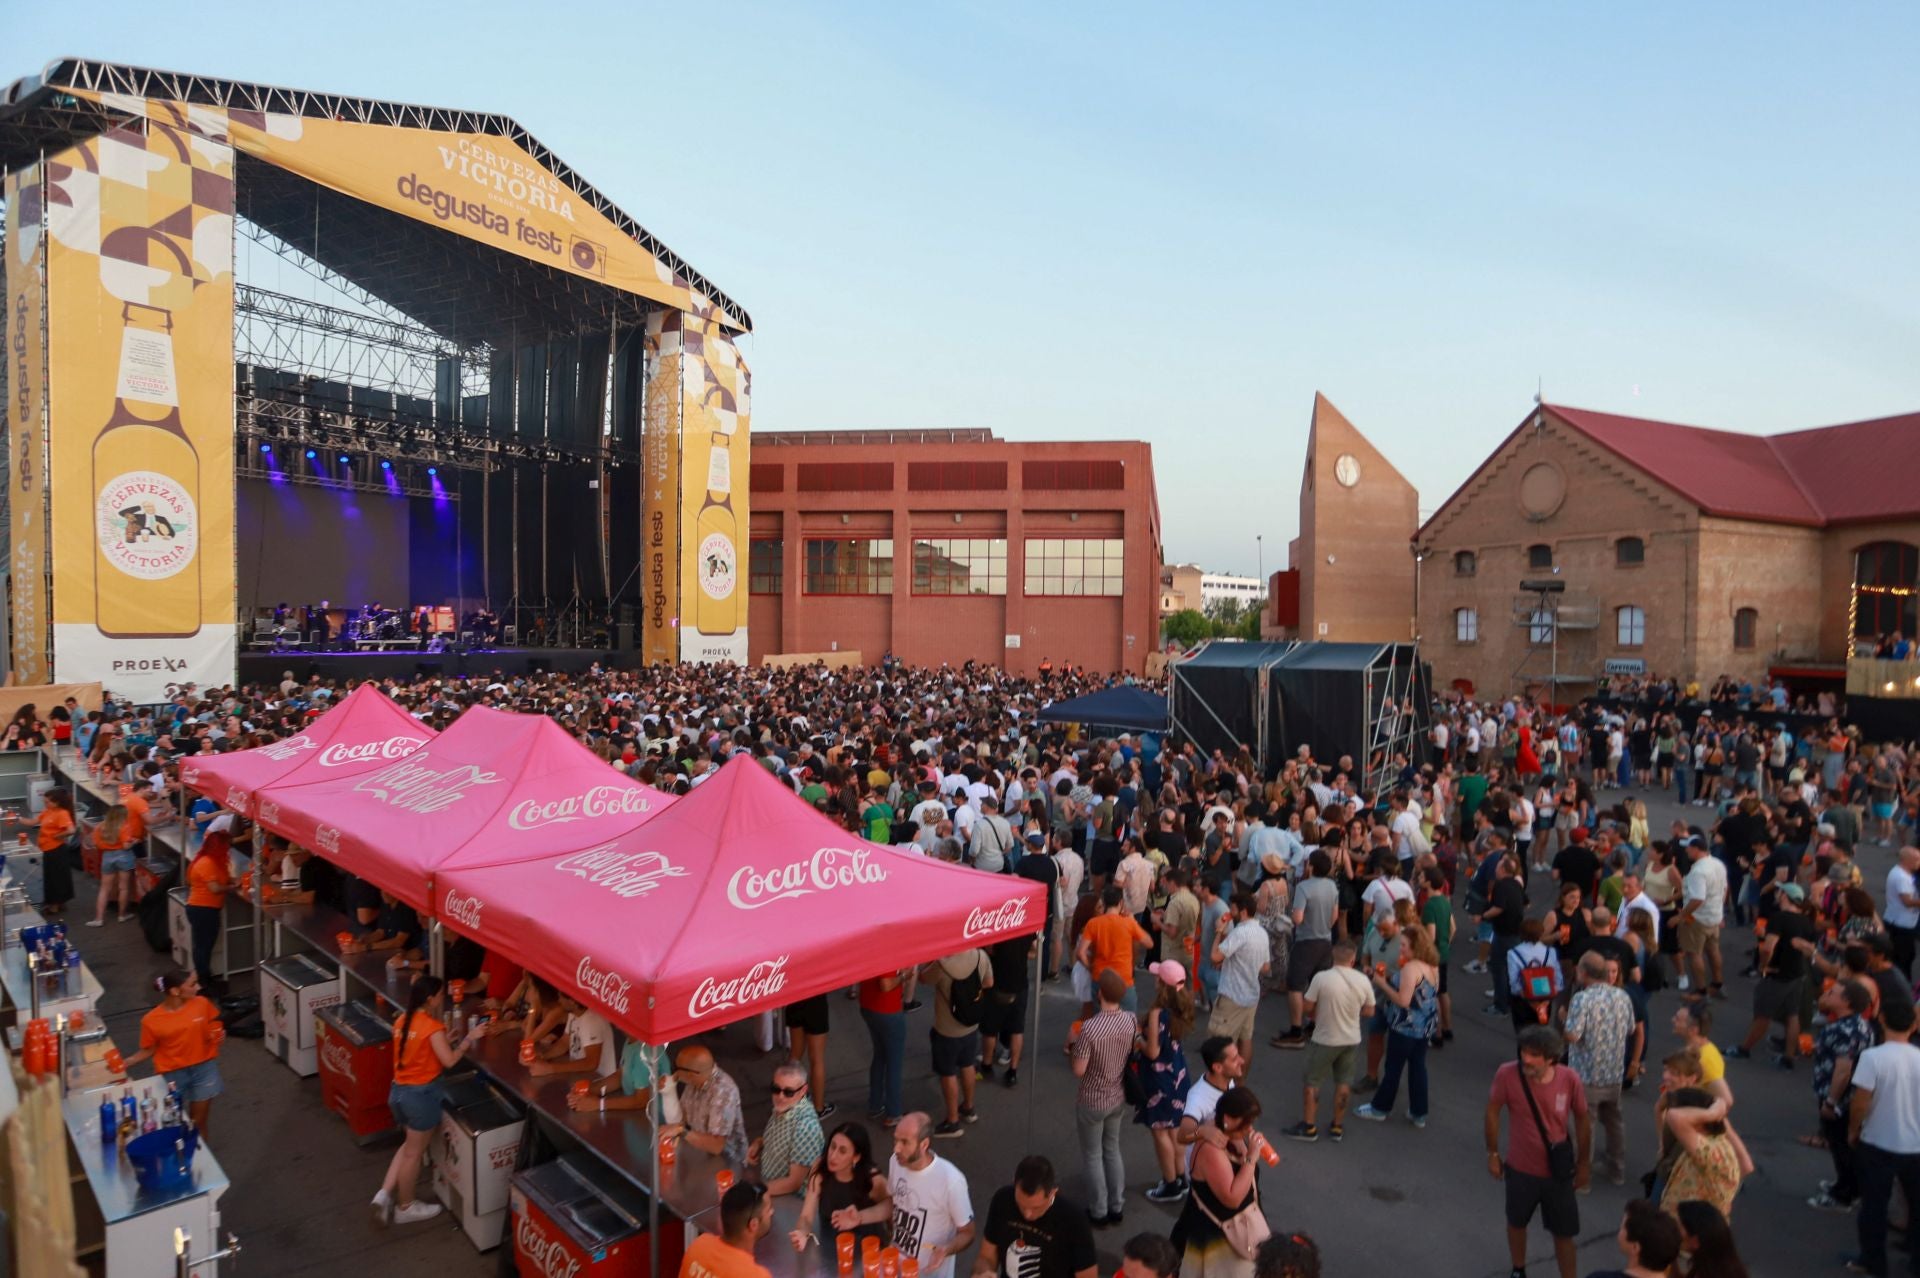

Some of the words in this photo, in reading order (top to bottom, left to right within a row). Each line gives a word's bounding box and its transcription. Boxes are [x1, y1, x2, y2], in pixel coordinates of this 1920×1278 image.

[438, 146, 576, 222] VICTORIA
[459, 139, 560, 194] CERVEZAS
[397, 173, 509, 236] degusta
[516, 217, 562, 256] fest
[14, 294, 31, 423] degusta
[658, 394, 668, 482] VICTORIA
[111, 483, 184, 514] CERVEZAS
[115, 539, 185, 568] VICTORIA
[652, 511, 663, 549] fest
[652, 553, 667, 629] degusta
[705, 575, 732, 593] VICTORIA
[112, 656, 188, 672] PROEXA
[702, 647, 732, 656] PROEXA
[319, 736, 431, 767] Coca-Co
[352, 751, 502, 814] Coca-Cola
[508, 786, 651, 830] Coca-Cola
[555, 842, 692, 899] Coca-Cola
[726, 847, 888, 909] Coca-Cola
[444, 888, 485, 930] Coca-Cola
[962, 896, 1030, 940] Coca-Cola
[308, 995, 341, 1008] VICTO
[576, 954, 632, 1015] Coca-Cola
[687, 953, 790, 1019] Coca-Cola
